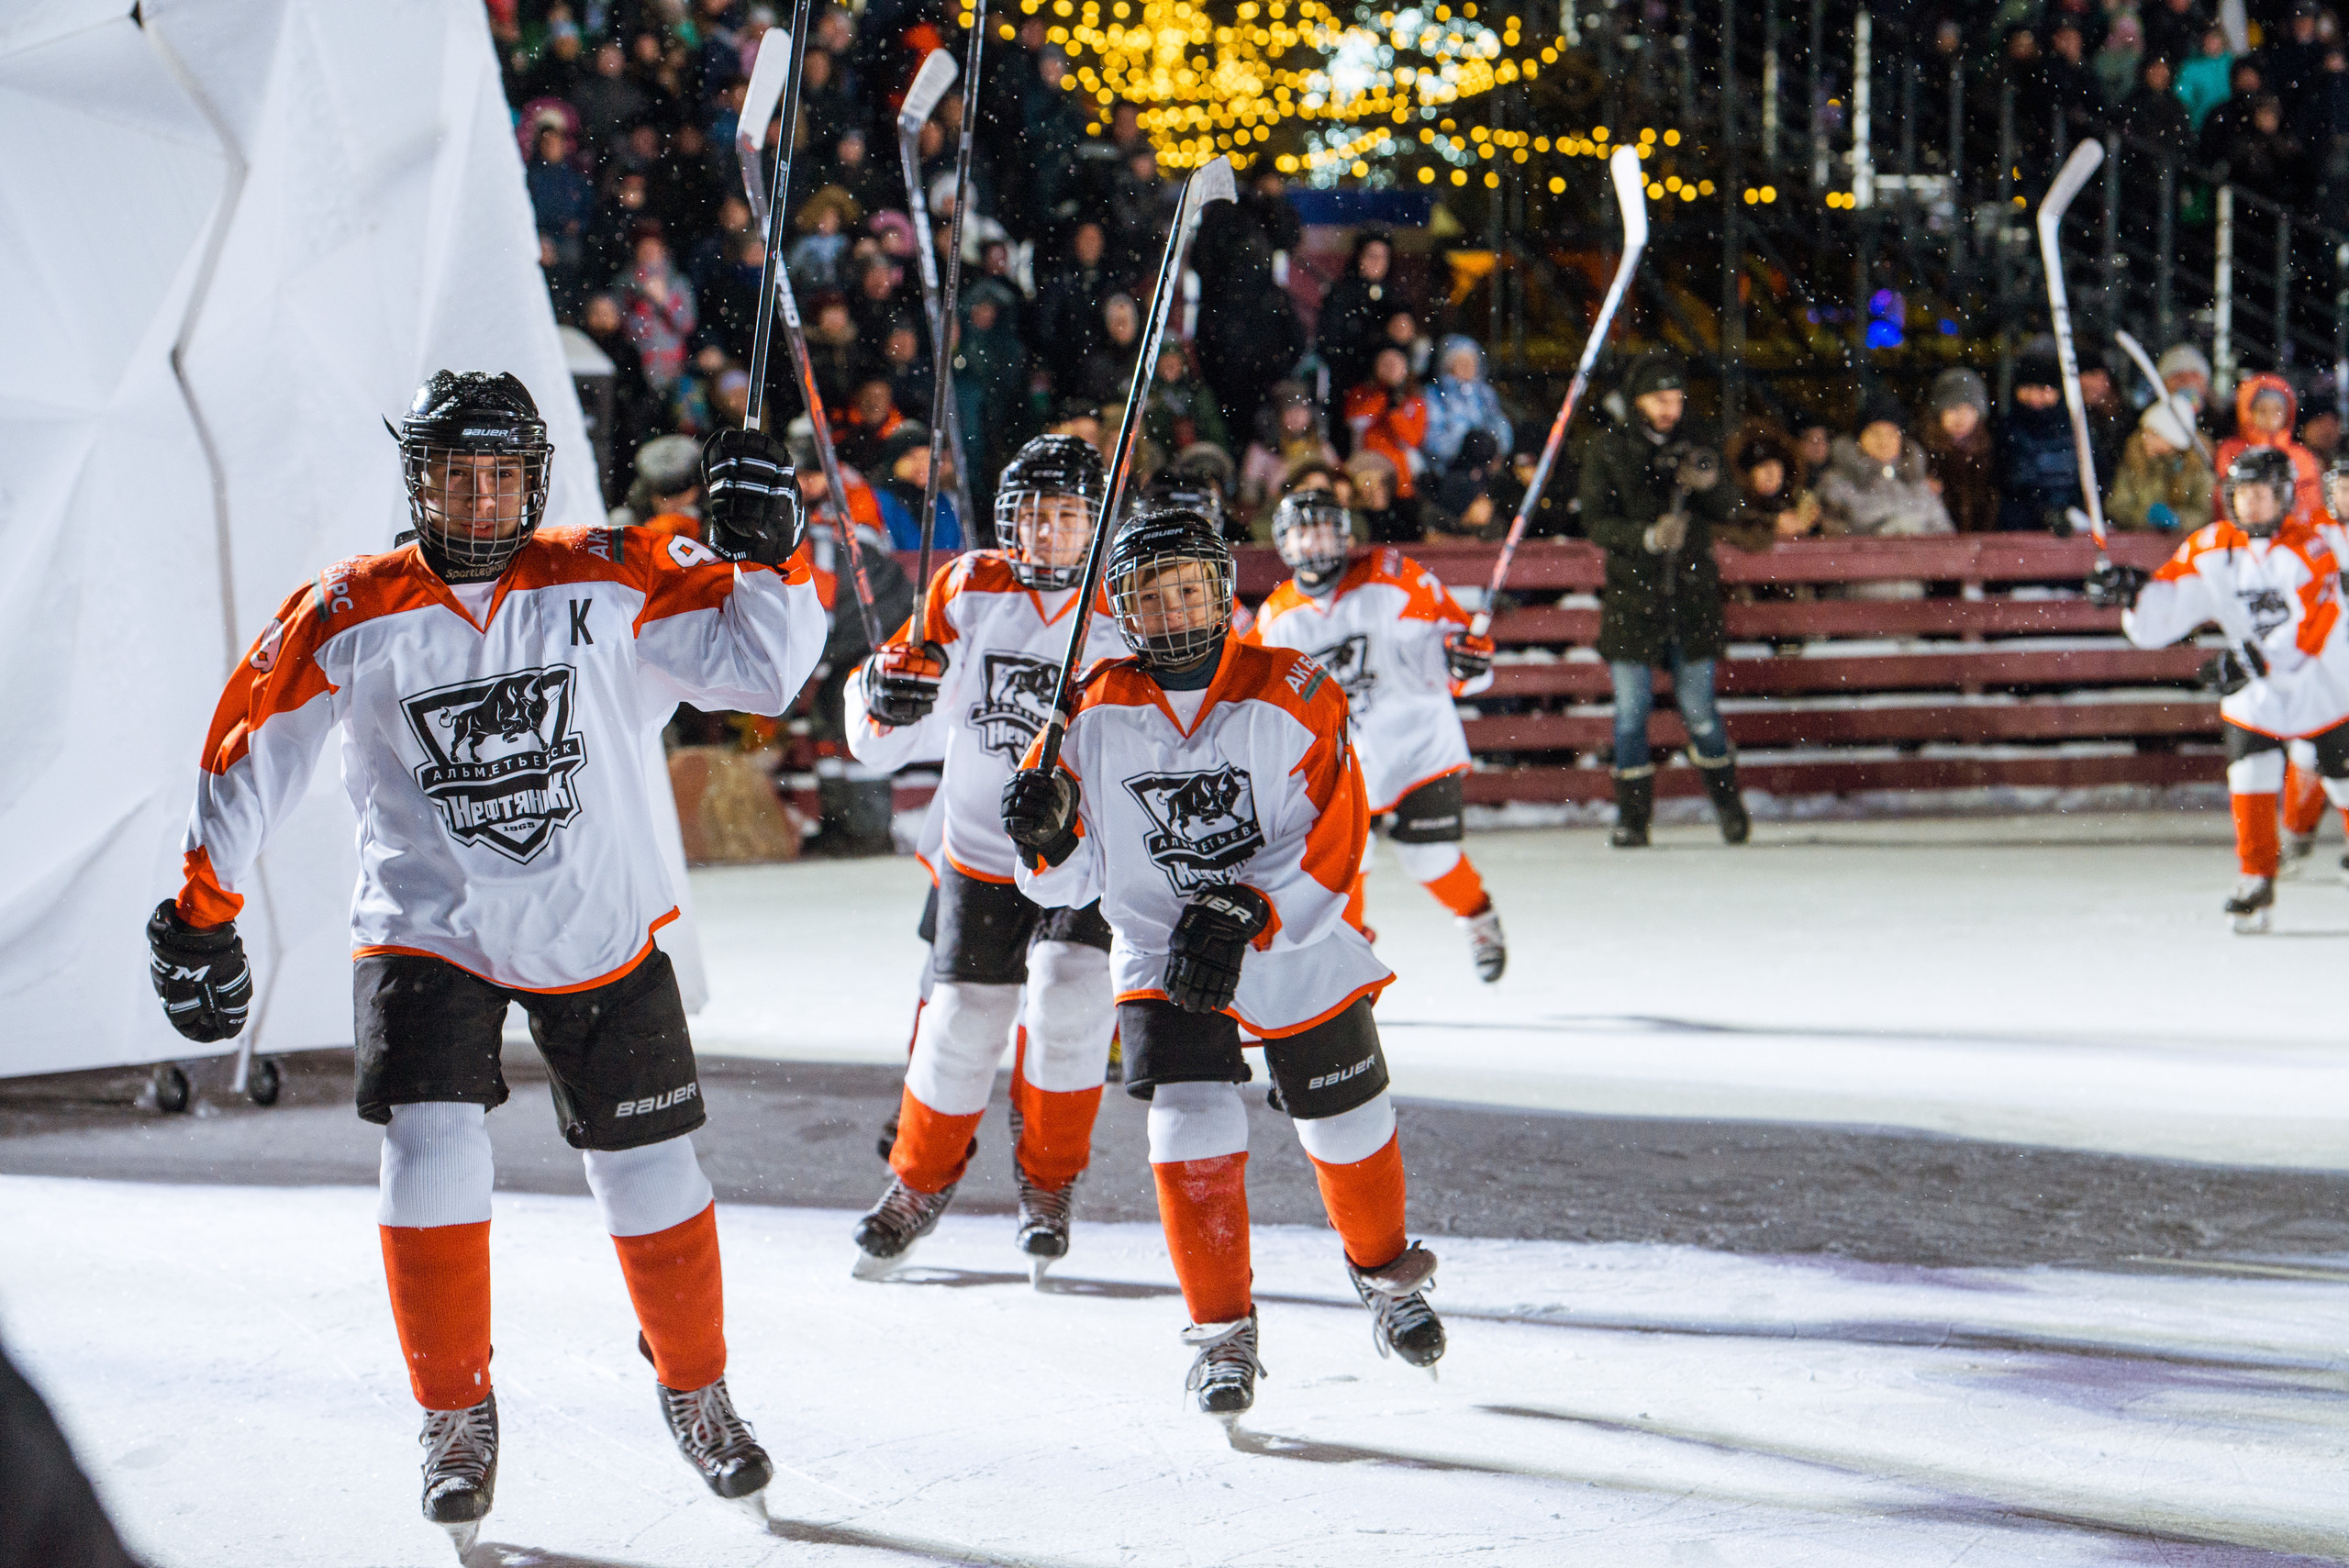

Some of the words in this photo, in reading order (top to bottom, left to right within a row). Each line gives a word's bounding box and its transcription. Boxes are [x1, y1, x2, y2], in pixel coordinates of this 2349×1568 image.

[462, 428, 509, 437] BAUER
[1142, 528, 1184, 540] BAUER
[445, 561, 508, 580] SportLegion
[1308, 1053, 1376, 1090] BAUER
[616, 1082, 697, 1118] BAUER
